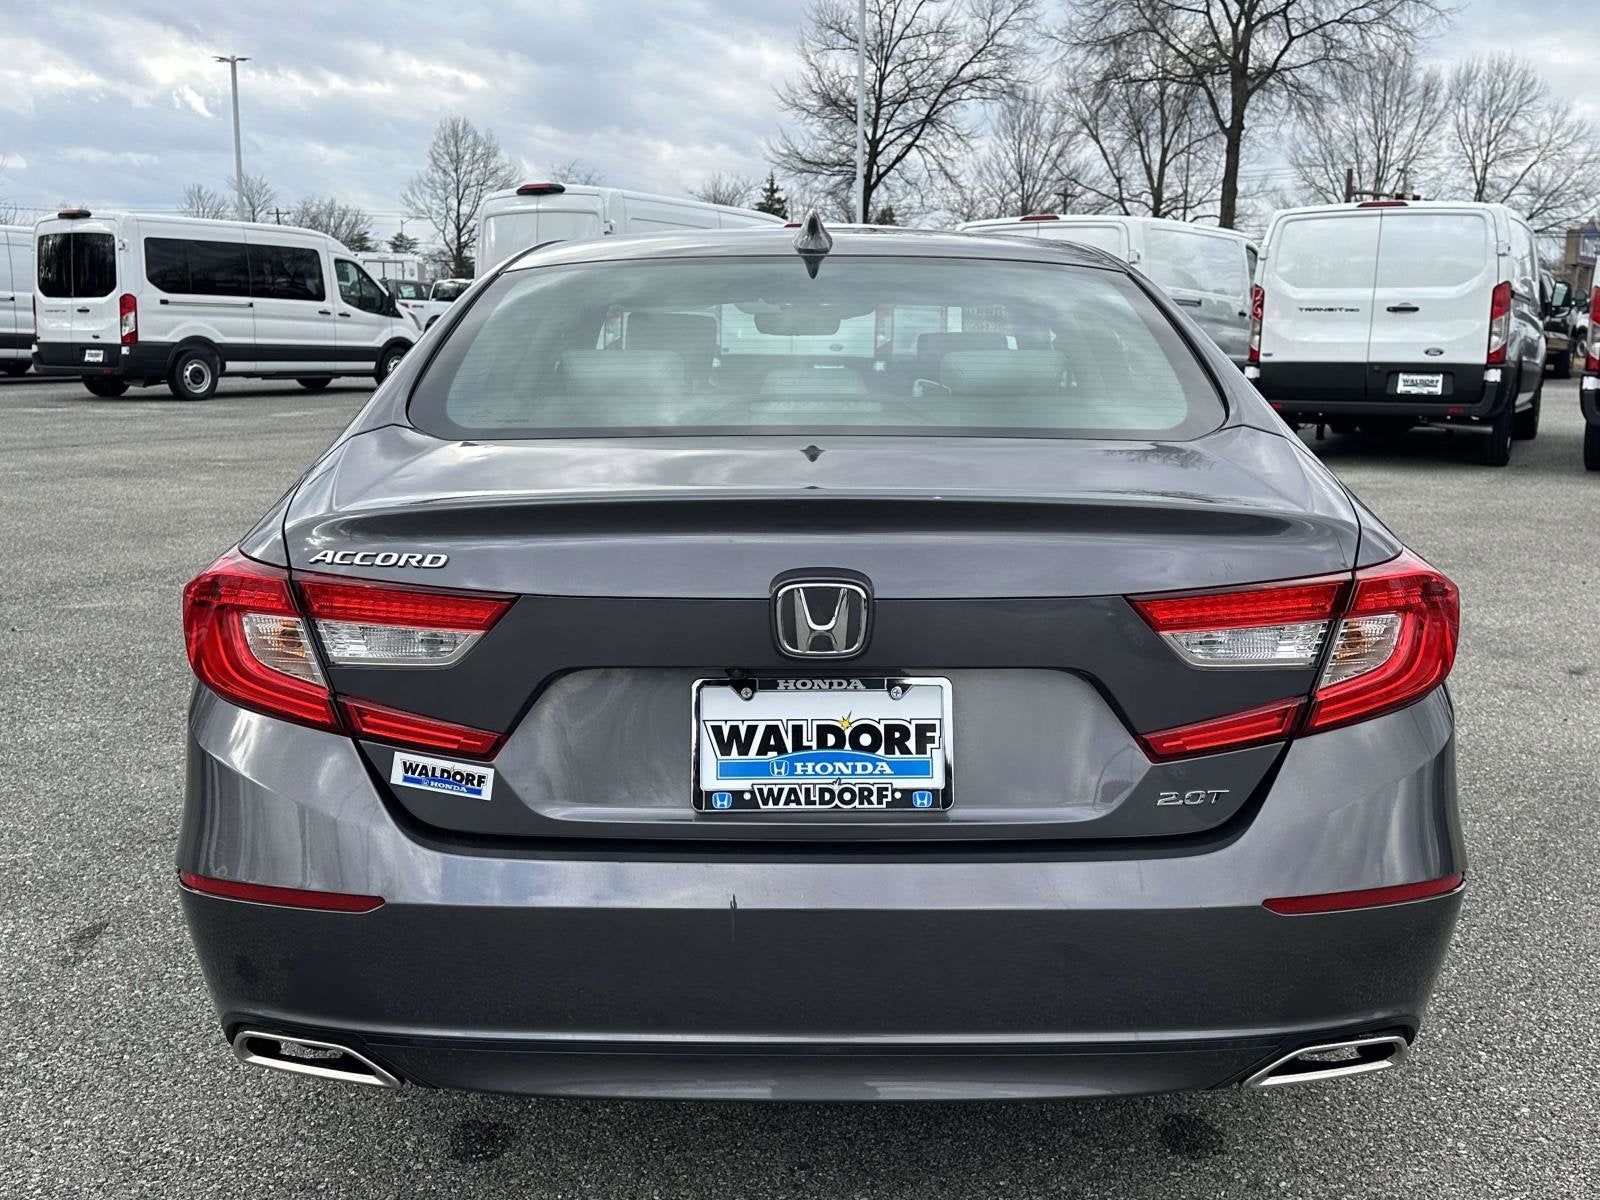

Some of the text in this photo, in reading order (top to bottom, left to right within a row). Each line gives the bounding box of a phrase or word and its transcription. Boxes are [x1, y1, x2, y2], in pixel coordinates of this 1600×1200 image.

[308, 550, 449, 568] ACCORD
[776, 679, 866, 690] HONDA
[707, 721, 939, 757] WALDORF
[402, 760, 488, 788] WALDORF
[793, 761, 894, 775] HONDA
[430, 781, 468, 793] HONDA
[755, 785, 893, 808] WALDORF
